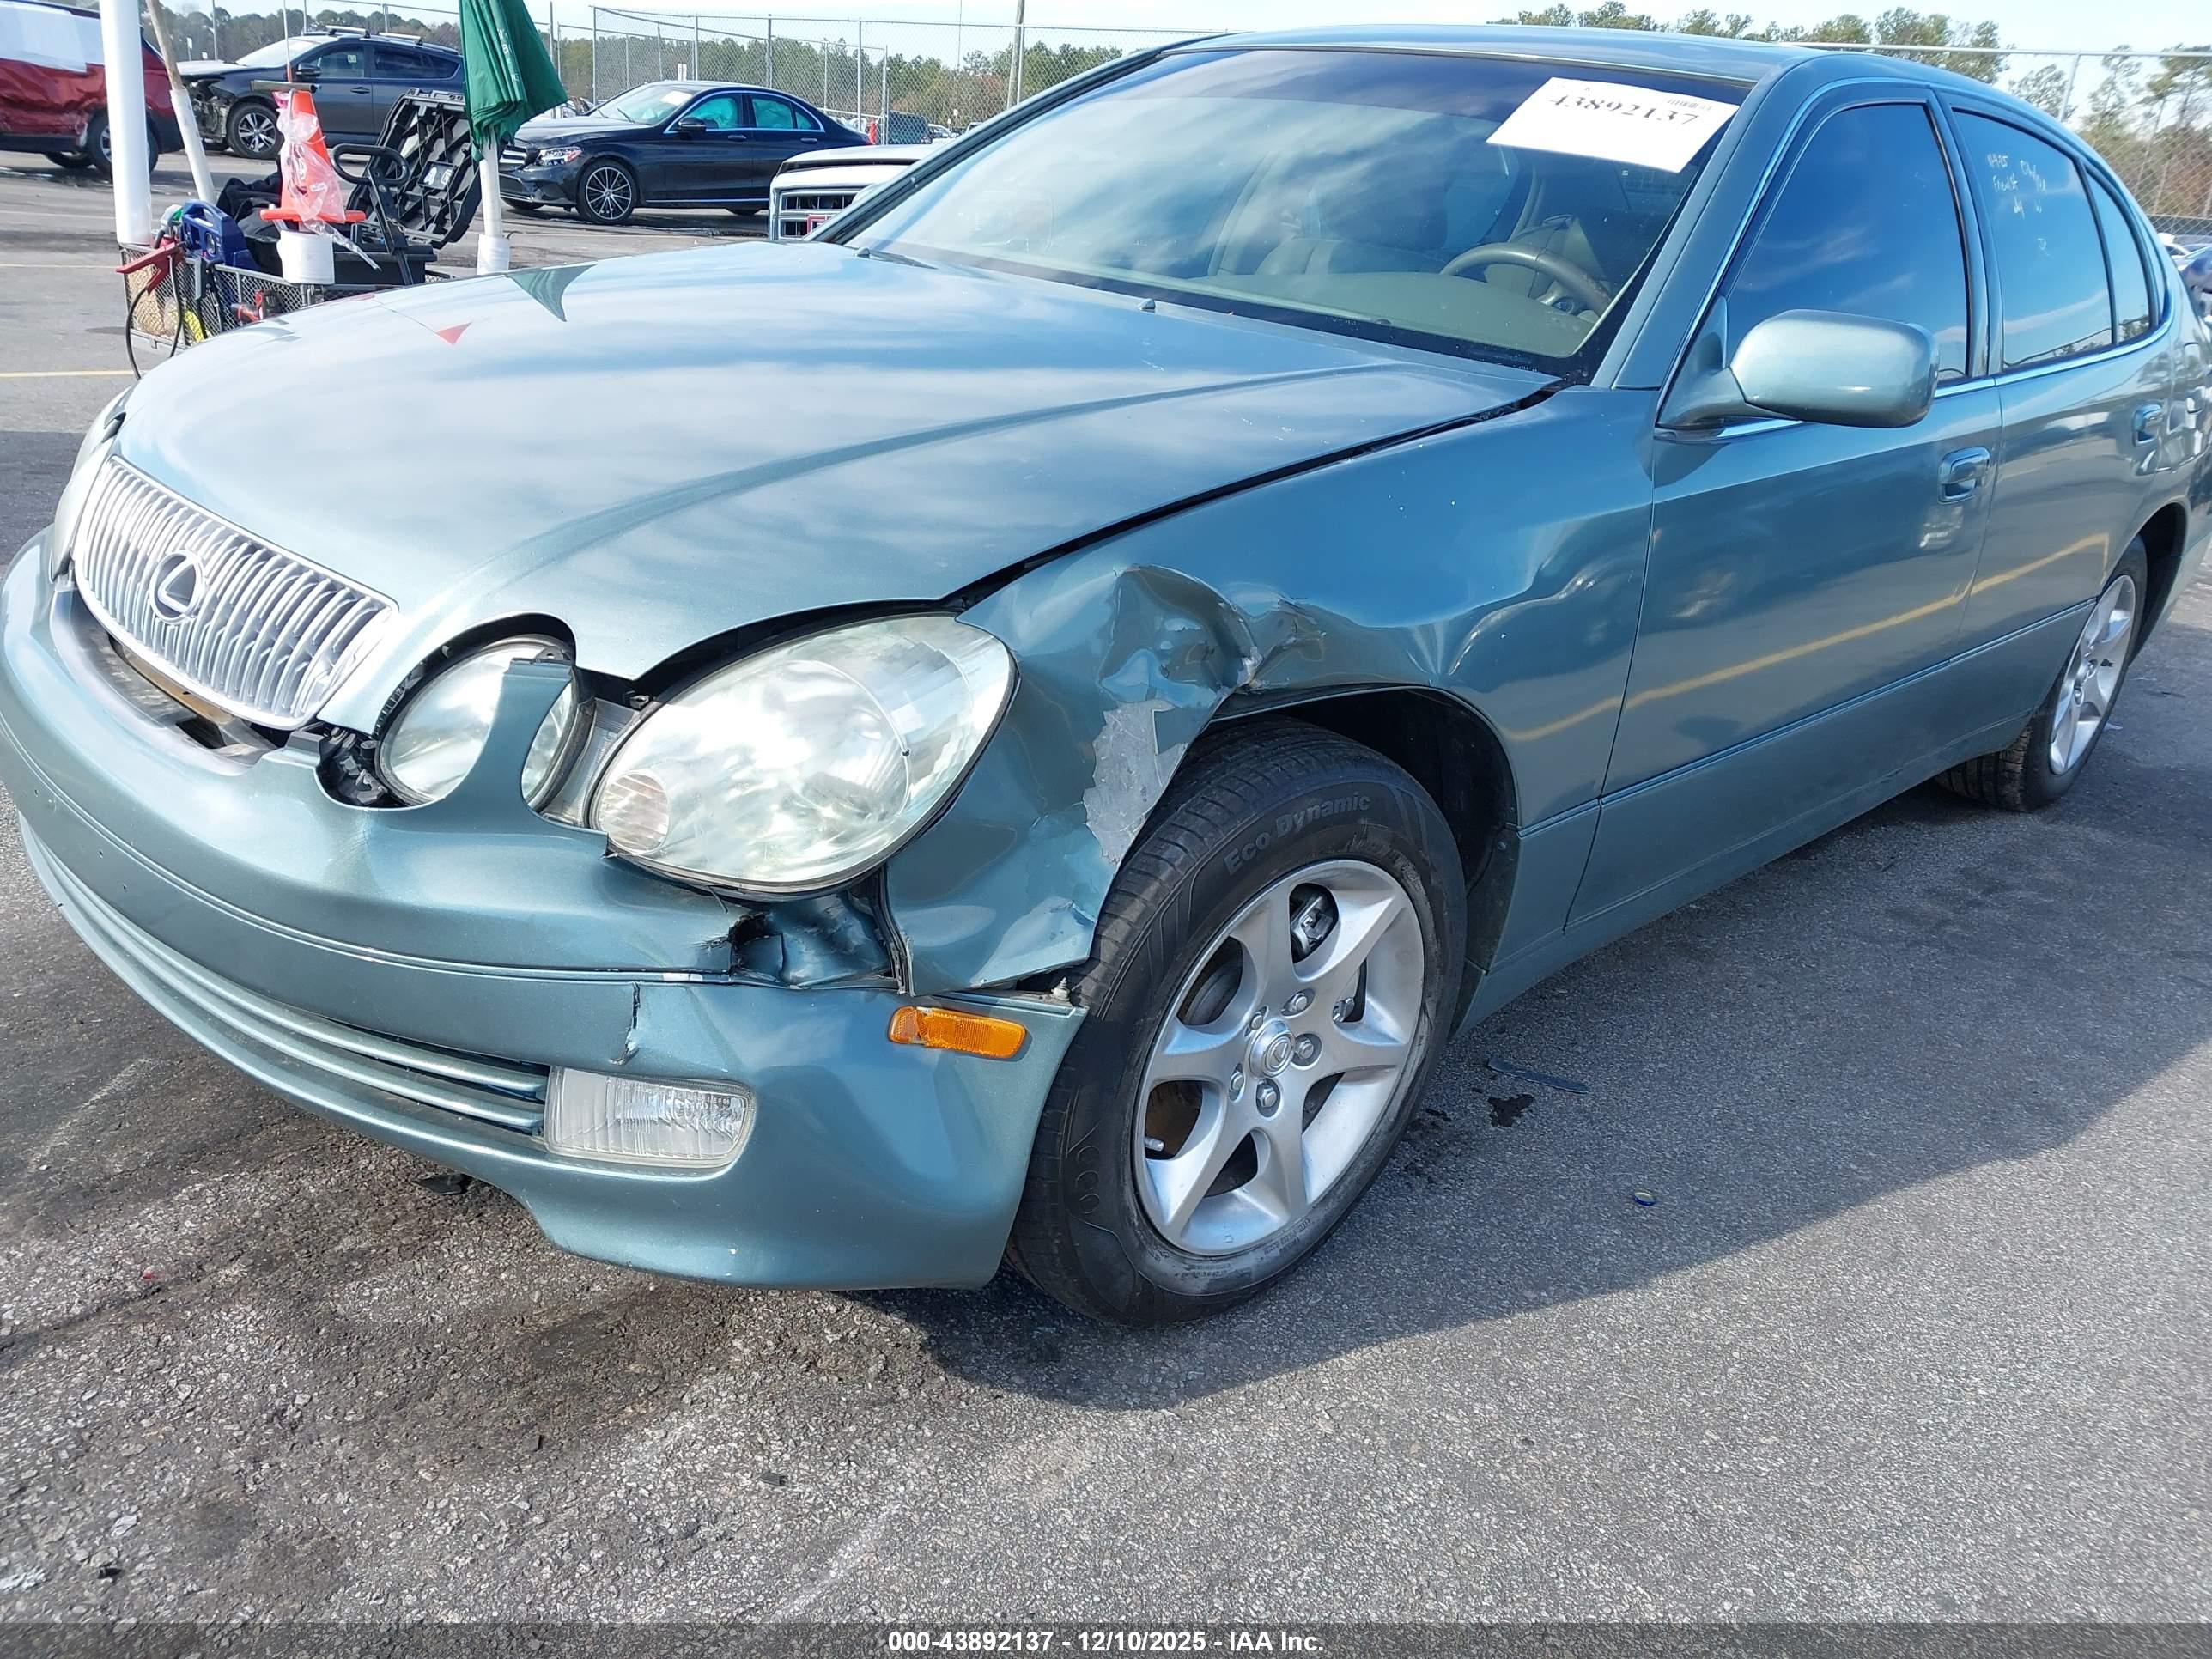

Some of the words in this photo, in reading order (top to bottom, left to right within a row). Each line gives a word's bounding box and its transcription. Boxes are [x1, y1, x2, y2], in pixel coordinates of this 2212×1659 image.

[1548, 94, 1700, 125] 43892137
[1224, 832, 1270, 876] Eco
[1275, 791, 1372, 838] Dynamic
